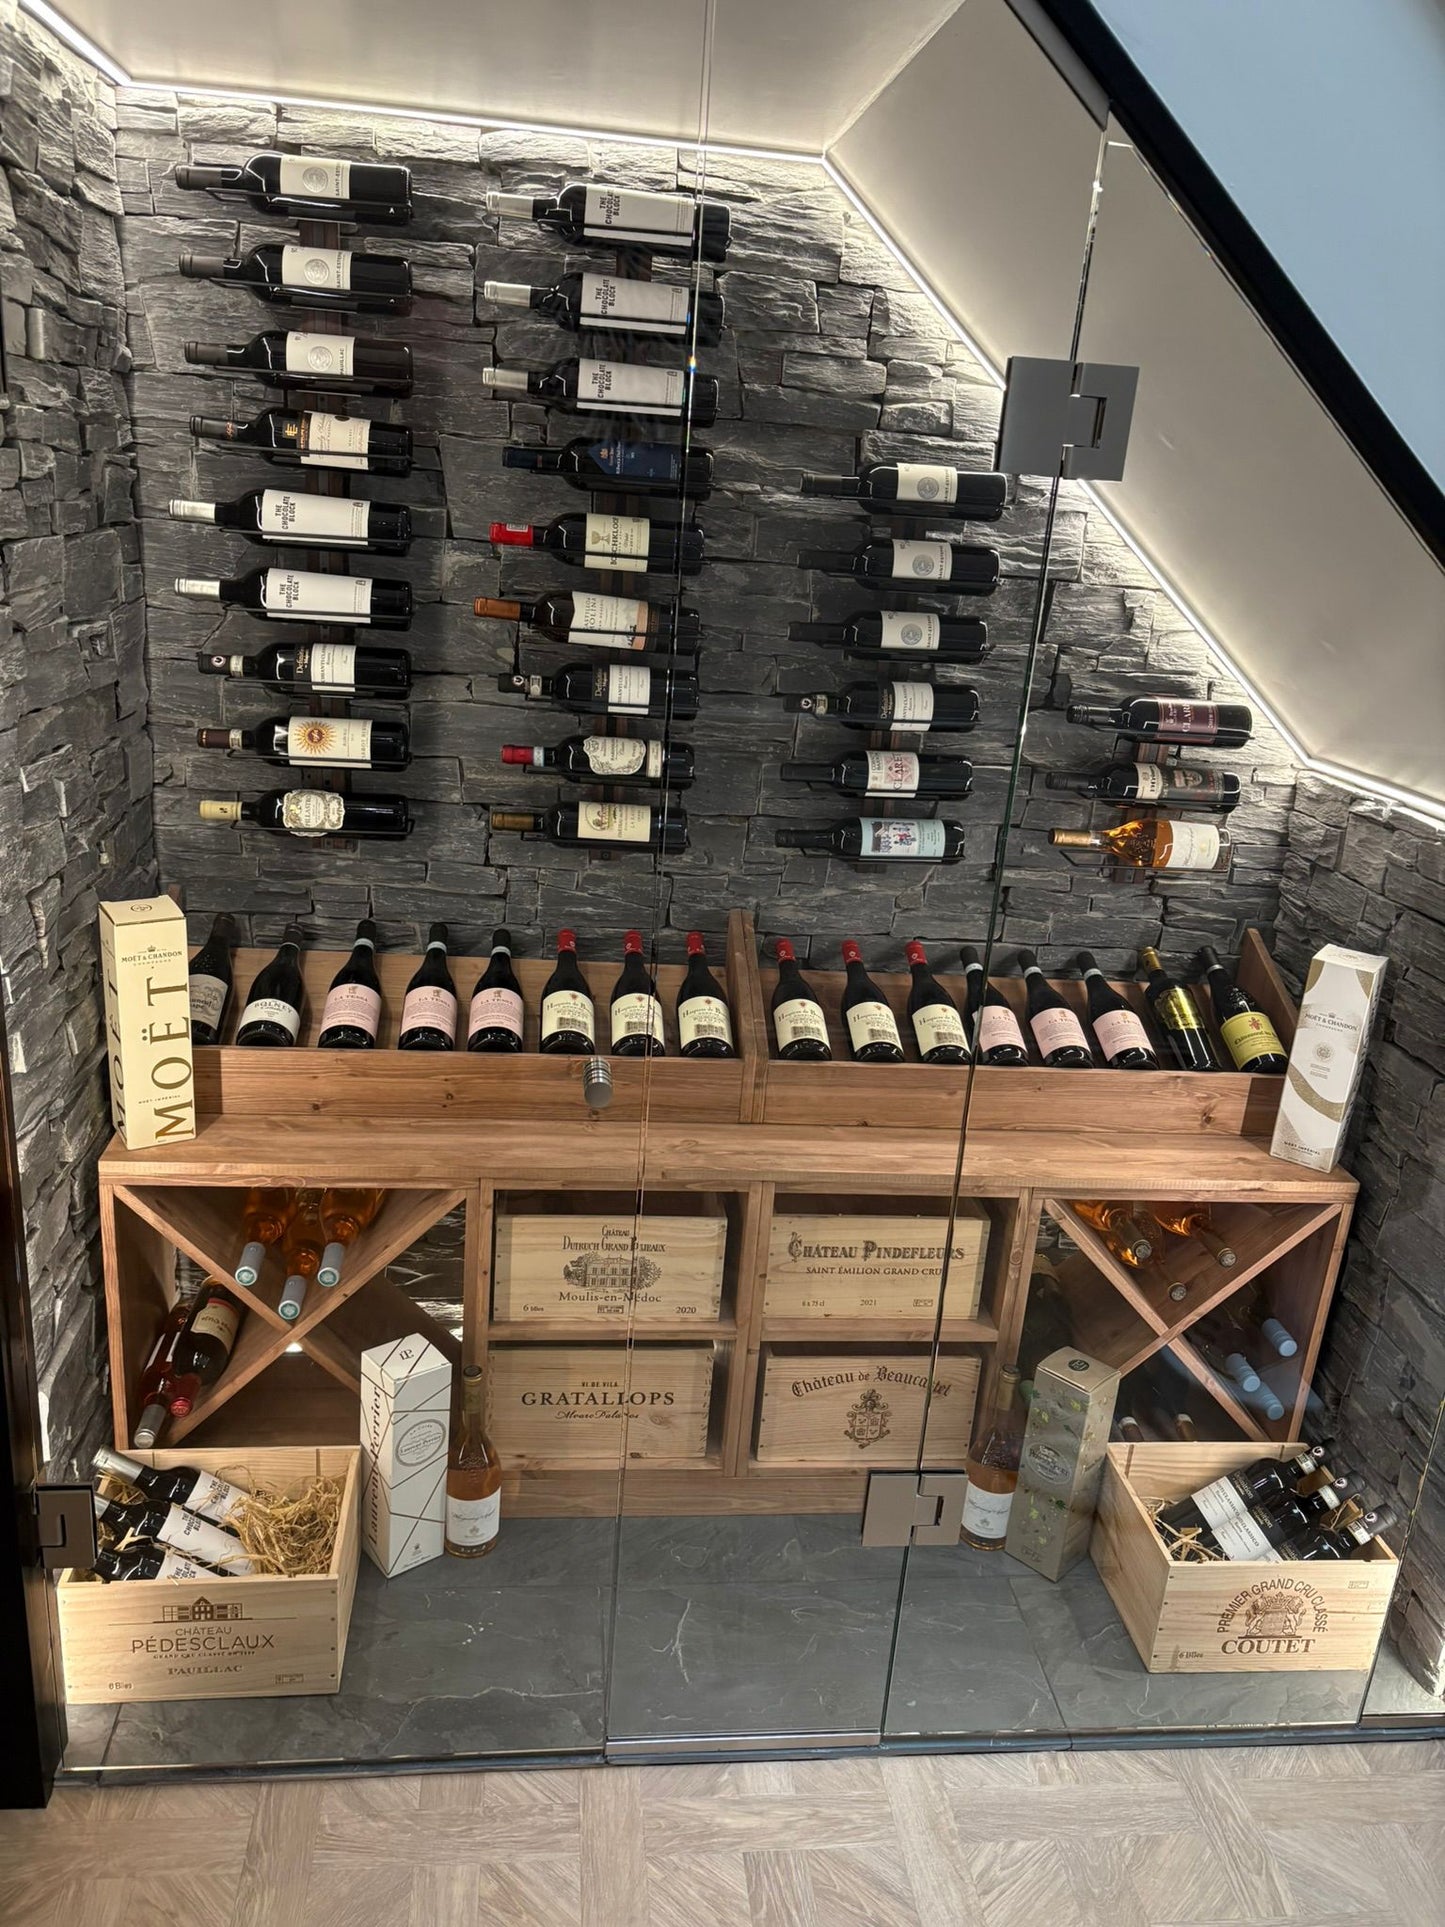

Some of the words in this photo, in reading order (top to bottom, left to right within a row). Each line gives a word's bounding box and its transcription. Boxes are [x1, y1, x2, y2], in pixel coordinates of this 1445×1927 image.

[595, 287, 603, 300] THE
[601, 279, 610, 314] CHOCOLATE
[608, 285, 616, 306] BLOCK
[598, 364, 606, 398] CHOCOLATE
[281, 496, 290, 530] CHOCOLATE
[288, 502, 296, 522] BLOCK
[610, 516, 619, 566] BOCHKLOOF
[279, 583, 287, 595] THE
[286, 574, 294, 608] CHOCOLATE
[147, 951, 183, 960] CHANDON
[1304, 1013, 1322, 1022] MOËT
[1327, 1019, 1358, 1032] CHANDON
[141, 975, 195, 1140] MOËT
[602, 1224, 630, 1237] CHÂTEAU
[562, 1235, 600, 1251] DUTRUCH
[601, 1236, 629, 1251] GRAND
[788, 1231, 858, 1263] CHÂTEAU
[861, 1239, 966, 1263] PINDEFLEUS
[806, 1266, 835, 1276] SAINT
[838, 1265, 881, 1276] ÉMILION
[883, 1267, 919, 1277] GRAND
[921, 1268, 942, 1277] CRU
[523, 1303, 529, 1312] 6
[675, 1305, 697, 1315] 2020
[860, 1299, 877, 1307] 2021
[791, 1371, 854, 1398] Château
[858, 1371, 870, 1382] de
[873, 1365, 952, 1397] Beaucatel
[521, 1391, 675, 1406] GRATALLOPS
[555, 1410, 594, 1420] Alvaro
[594, 1409, 640, 1420] Palaos
[369, 1386, 382, 1460] Perrier
[208, 1479, 217, 1489] THE
[221, 1484, 231, 1500] BLOCK
[1217, 1590, 1252, 1634] PREMIER
[1251, 1578, 1294, 1596] GRAND
[1294, 1580, 1318, 1599] CRU
[1310, 1595, 1329, 1634] CLASSÉ
[175, 1626, 232, 1637] CHÂTEAU
[131, 1634, 275, 1653] PÉDESCLAUX
[1221, 1638, 1316, 1655] COUTET
[168, 1665, 243, 1675] PAUILLAC
